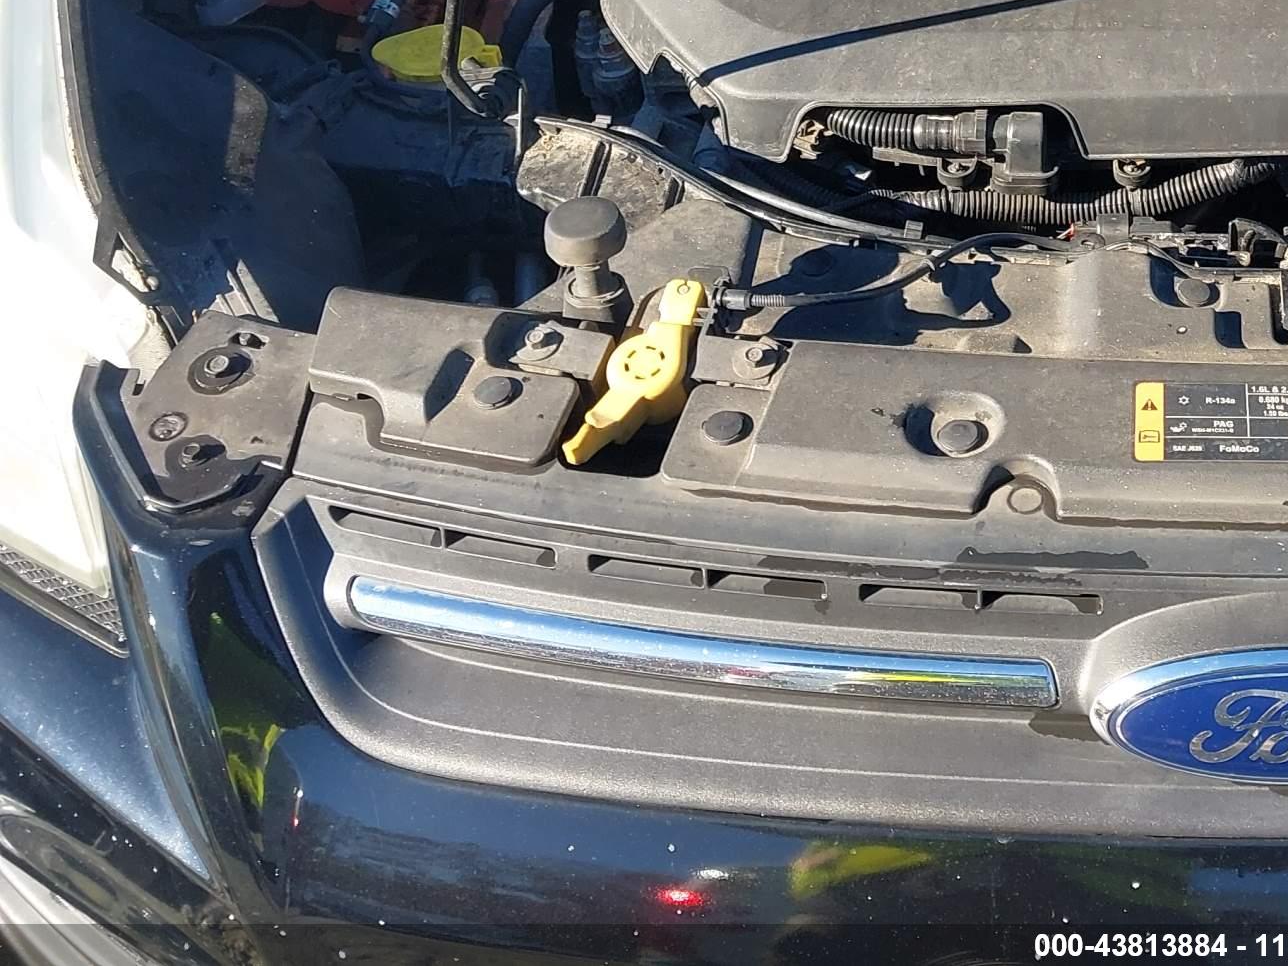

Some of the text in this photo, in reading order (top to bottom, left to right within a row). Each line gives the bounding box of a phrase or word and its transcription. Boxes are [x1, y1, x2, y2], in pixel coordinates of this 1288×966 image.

[1205, 396, 1236, 405] R-134a
[1213, 420, 1234, 428] PAG
[1219, 445, 1260, 453] FoMoCo
